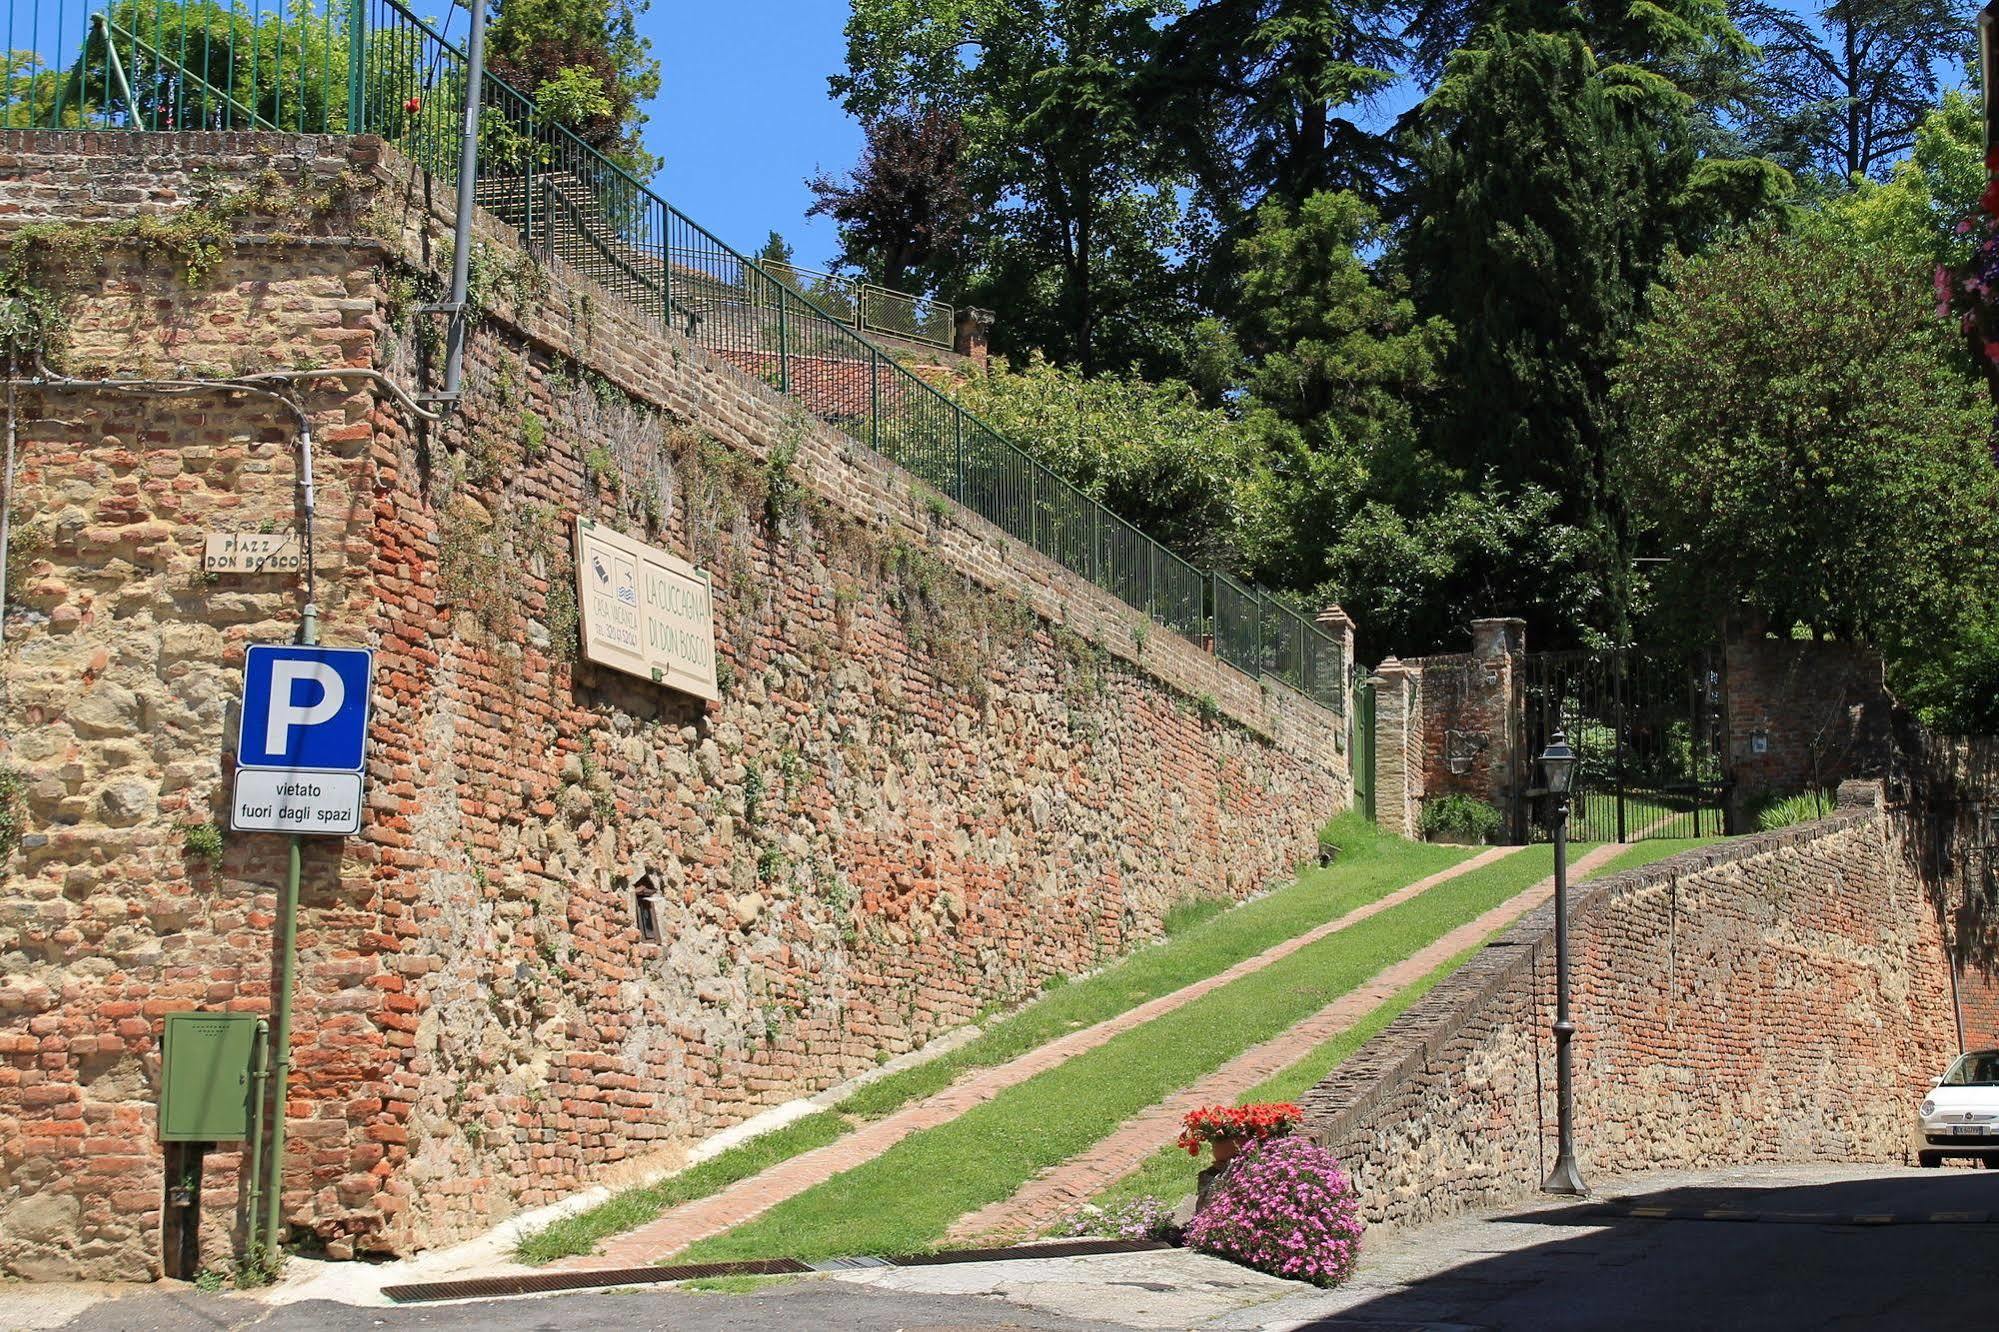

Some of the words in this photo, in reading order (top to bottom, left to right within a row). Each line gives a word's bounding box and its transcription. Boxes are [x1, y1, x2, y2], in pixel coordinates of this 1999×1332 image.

[207, 555, 238, 568] DON
[245, 555, 299, 569] BOSCO
[645, 573, 659, 607] LA
[659, 579, 705, 624] CUCCAGNA
[660, 621, 679, 657] DON
[680, 629, 708, 668] BOSCO
[265, 660, 345, 755] P
[276, 783, 321, 797] vietato
[241, 804, 272, 818] fuori
[279, 806, 311, 823] dagli
[317, 808, 351, 824] spazi
